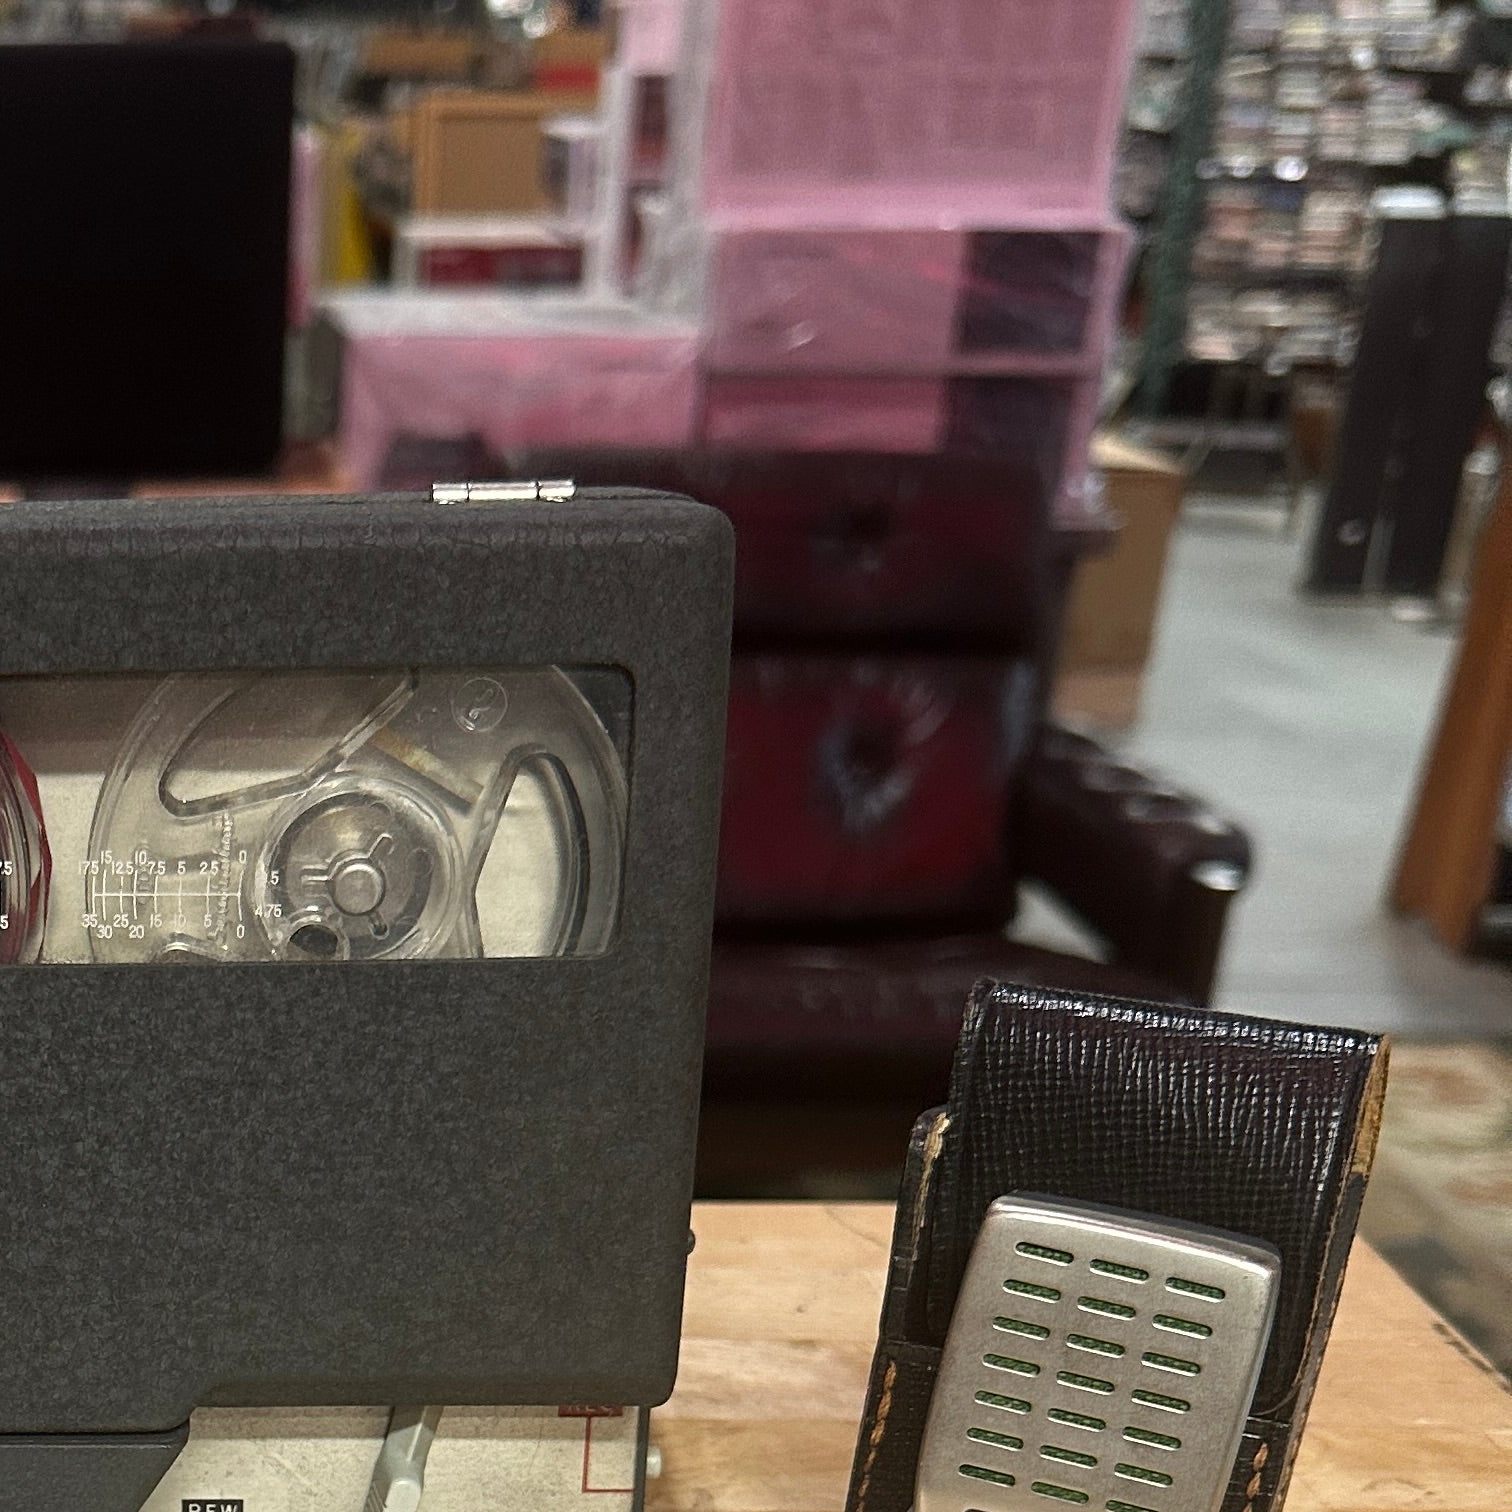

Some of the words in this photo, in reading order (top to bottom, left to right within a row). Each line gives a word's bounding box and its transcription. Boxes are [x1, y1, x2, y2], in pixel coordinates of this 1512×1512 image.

[100, 850, 113, 865] 15
[134, 850, 147, 865] 10
[177, 861, 186, 875] 5
[238, 850, 247, 865] 0
[82, 913, 98, 929] 35
[96, 924, 113, 939] 30
[113, 913, 129, 929] 25
[128, 924, 145, 939] 20
[149, 913, 163, 928] 15
[203, 914, 212, 928] 5
[237, 924, 245, 939] 0
